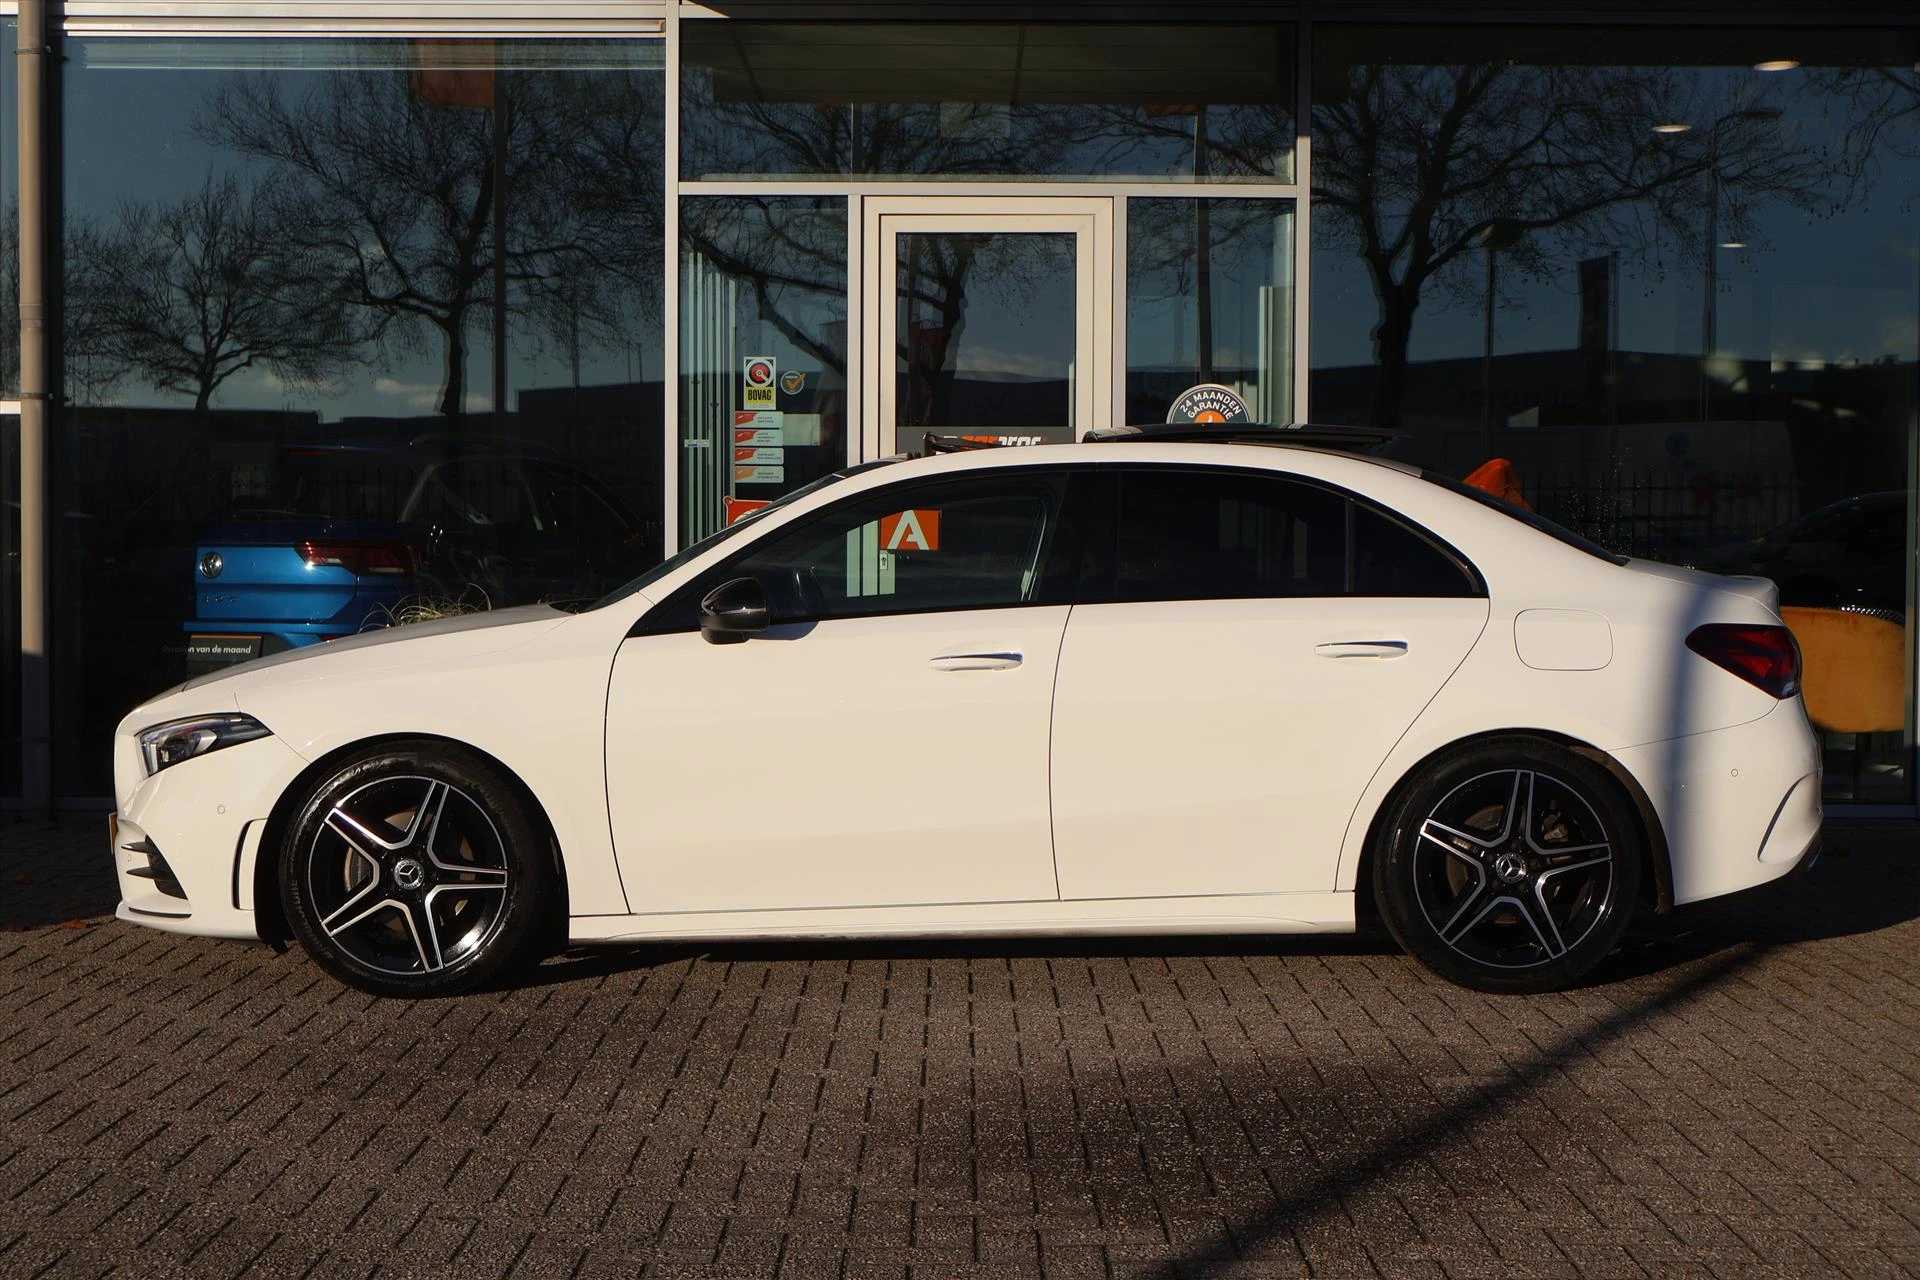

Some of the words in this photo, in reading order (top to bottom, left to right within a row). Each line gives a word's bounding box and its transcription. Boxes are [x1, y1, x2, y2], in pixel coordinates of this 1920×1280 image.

[747, 389, 772, 401] BOVAG
[1180, 400, 1192, 413] 24
[1193, 391, 1242, 414] MAANDEN
[1187, 401, 1234, 420] GARANTIE
[211, 644, 222, 653] de
[223, 645, 252, 654] maand
